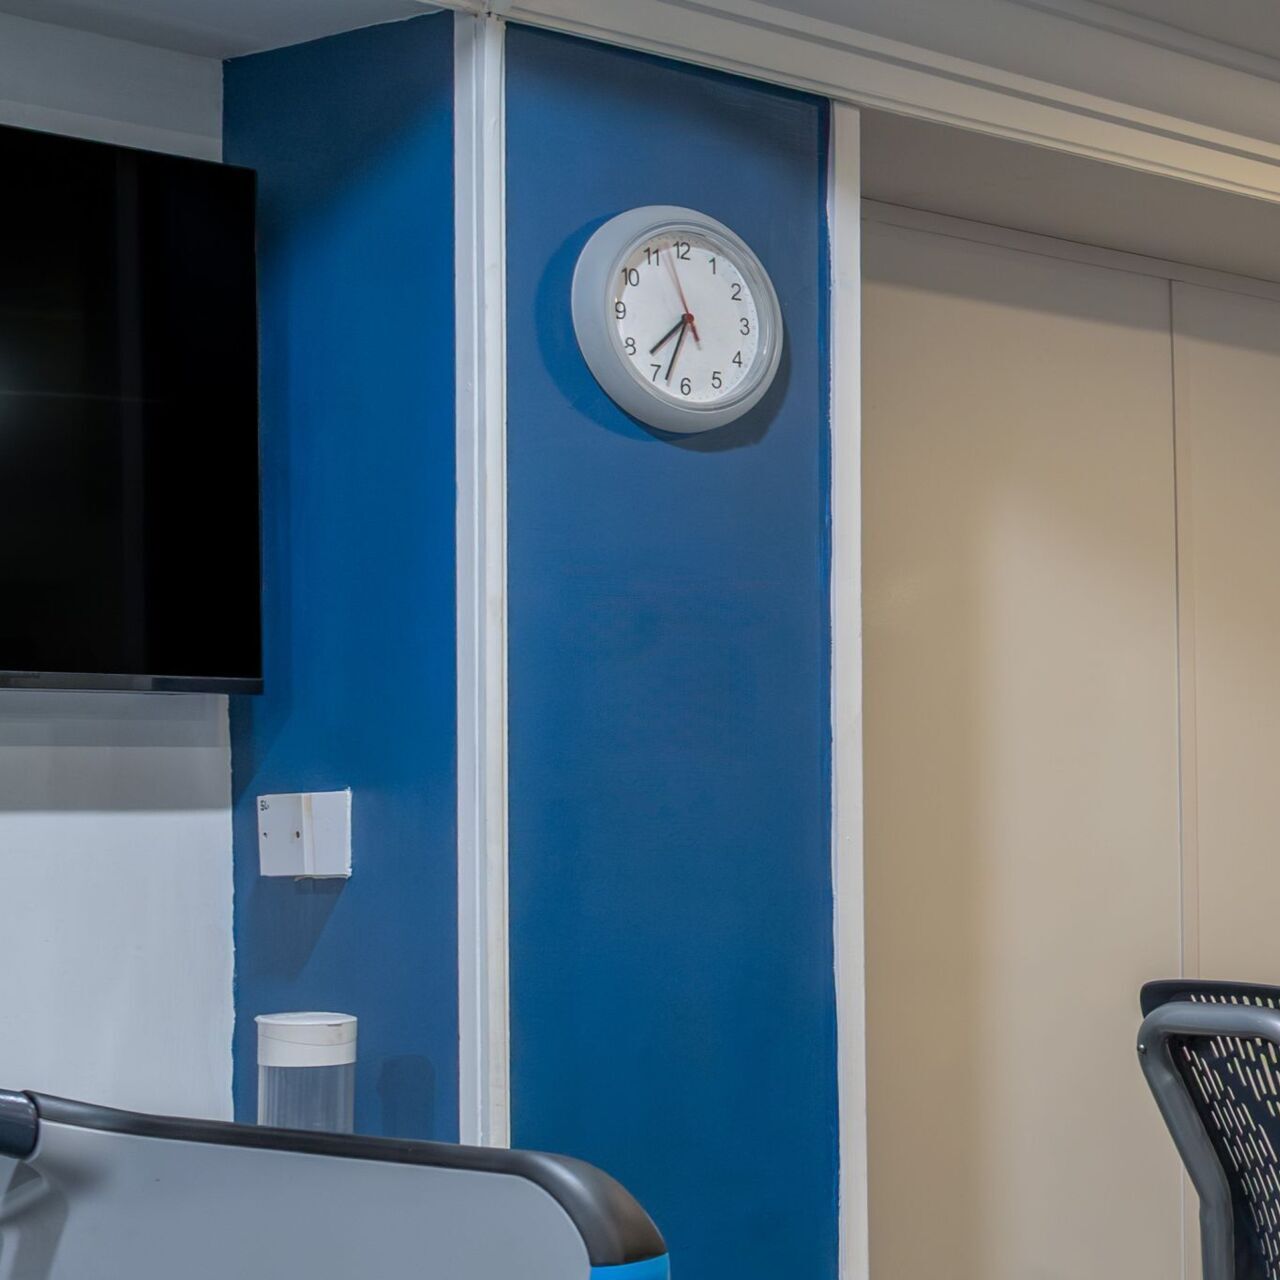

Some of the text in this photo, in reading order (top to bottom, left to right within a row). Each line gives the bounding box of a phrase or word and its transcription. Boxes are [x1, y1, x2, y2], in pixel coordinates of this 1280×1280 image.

[643, 247, 660, 266] 11
[673, 241, 691, 260] 12
[709, 258, 716, 275] 1
[621, 268, 640, 286] 10
[731, 283, 742, 301] 2
[615, 301, 626, 319] 9
[739, 318, 750, 335] 3
[624, 337, 636, 355] 8
[732, 351, 743, 367] 4
[650, 364, 661, 382] 7
[711, 371, 722, 389] 5
[680, 378, 691, 395] 6
